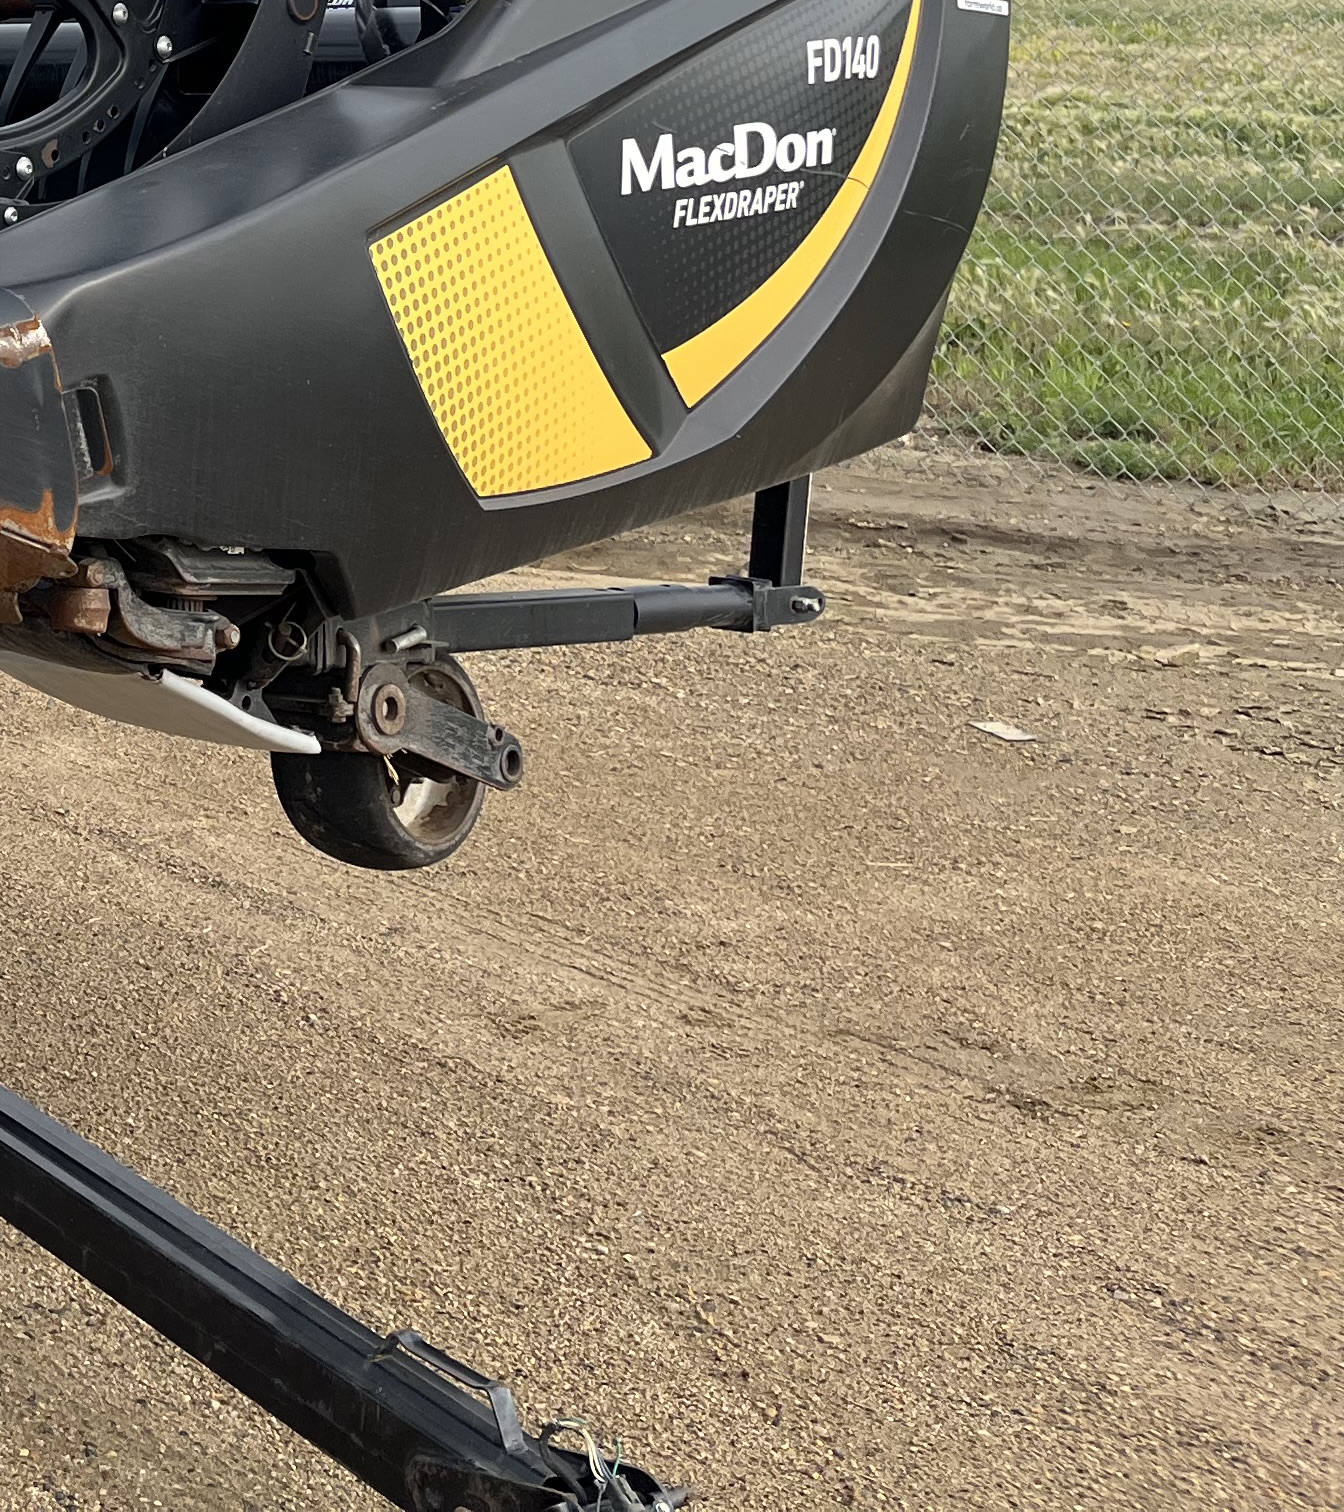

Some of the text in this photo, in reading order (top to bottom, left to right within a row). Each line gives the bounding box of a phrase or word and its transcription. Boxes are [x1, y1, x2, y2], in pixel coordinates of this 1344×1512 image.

[806, 34, 879, 84] FD140
[620, 121, 834, 195] MacDon
[672, 181, 803, 228] FLEXDRAPER
